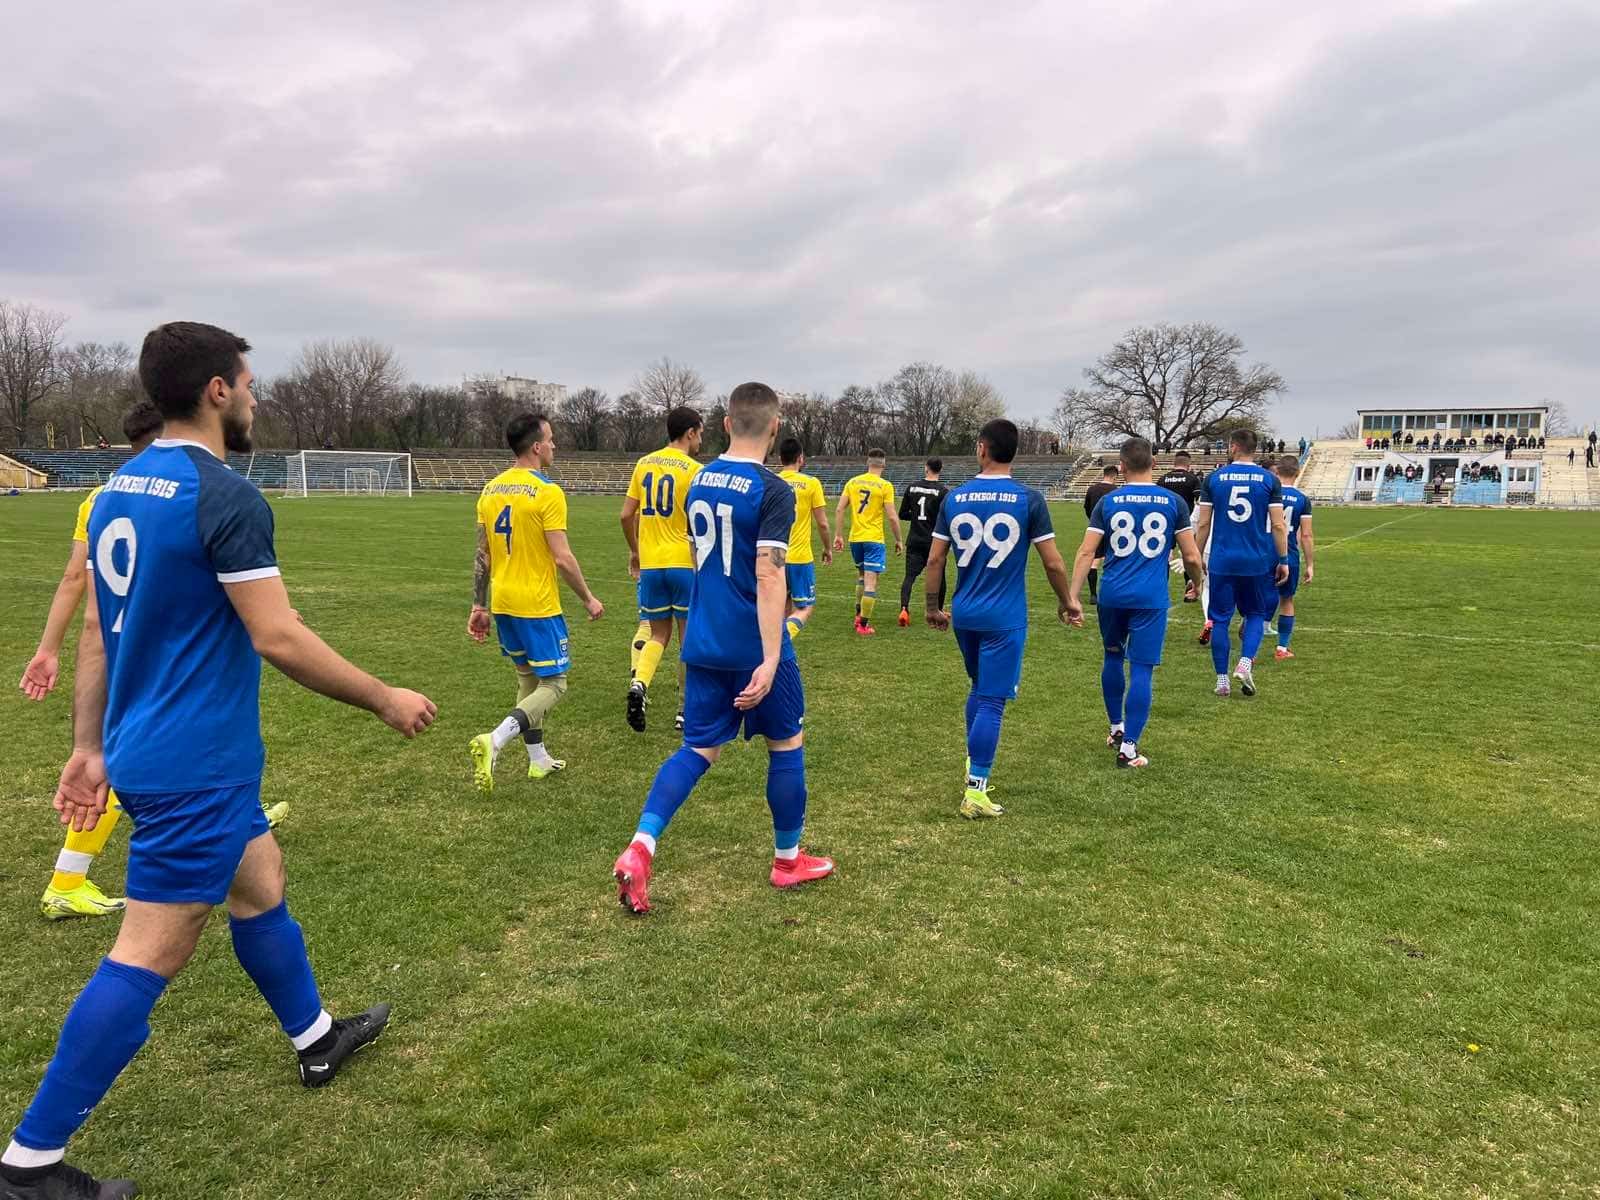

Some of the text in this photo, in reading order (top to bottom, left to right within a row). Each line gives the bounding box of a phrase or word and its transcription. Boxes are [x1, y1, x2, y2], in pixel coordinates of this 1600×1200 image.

[147, 476, 180, 499] 1915
[641, 471, 675, 517] 10
[728, 475, 753, 494] 1915
[858, 489, 871, 514] 7
[998, 492, 1018, 503] 1915
[917, 496, 927, 520] 1
[1227, 486, 1252, 523] 5
[494, 504, 513, 555] 4
[689, 500, 733, 577] 91
[949, 512, 1020, 569] 99
[1110, 511, 1168, 559] 88
